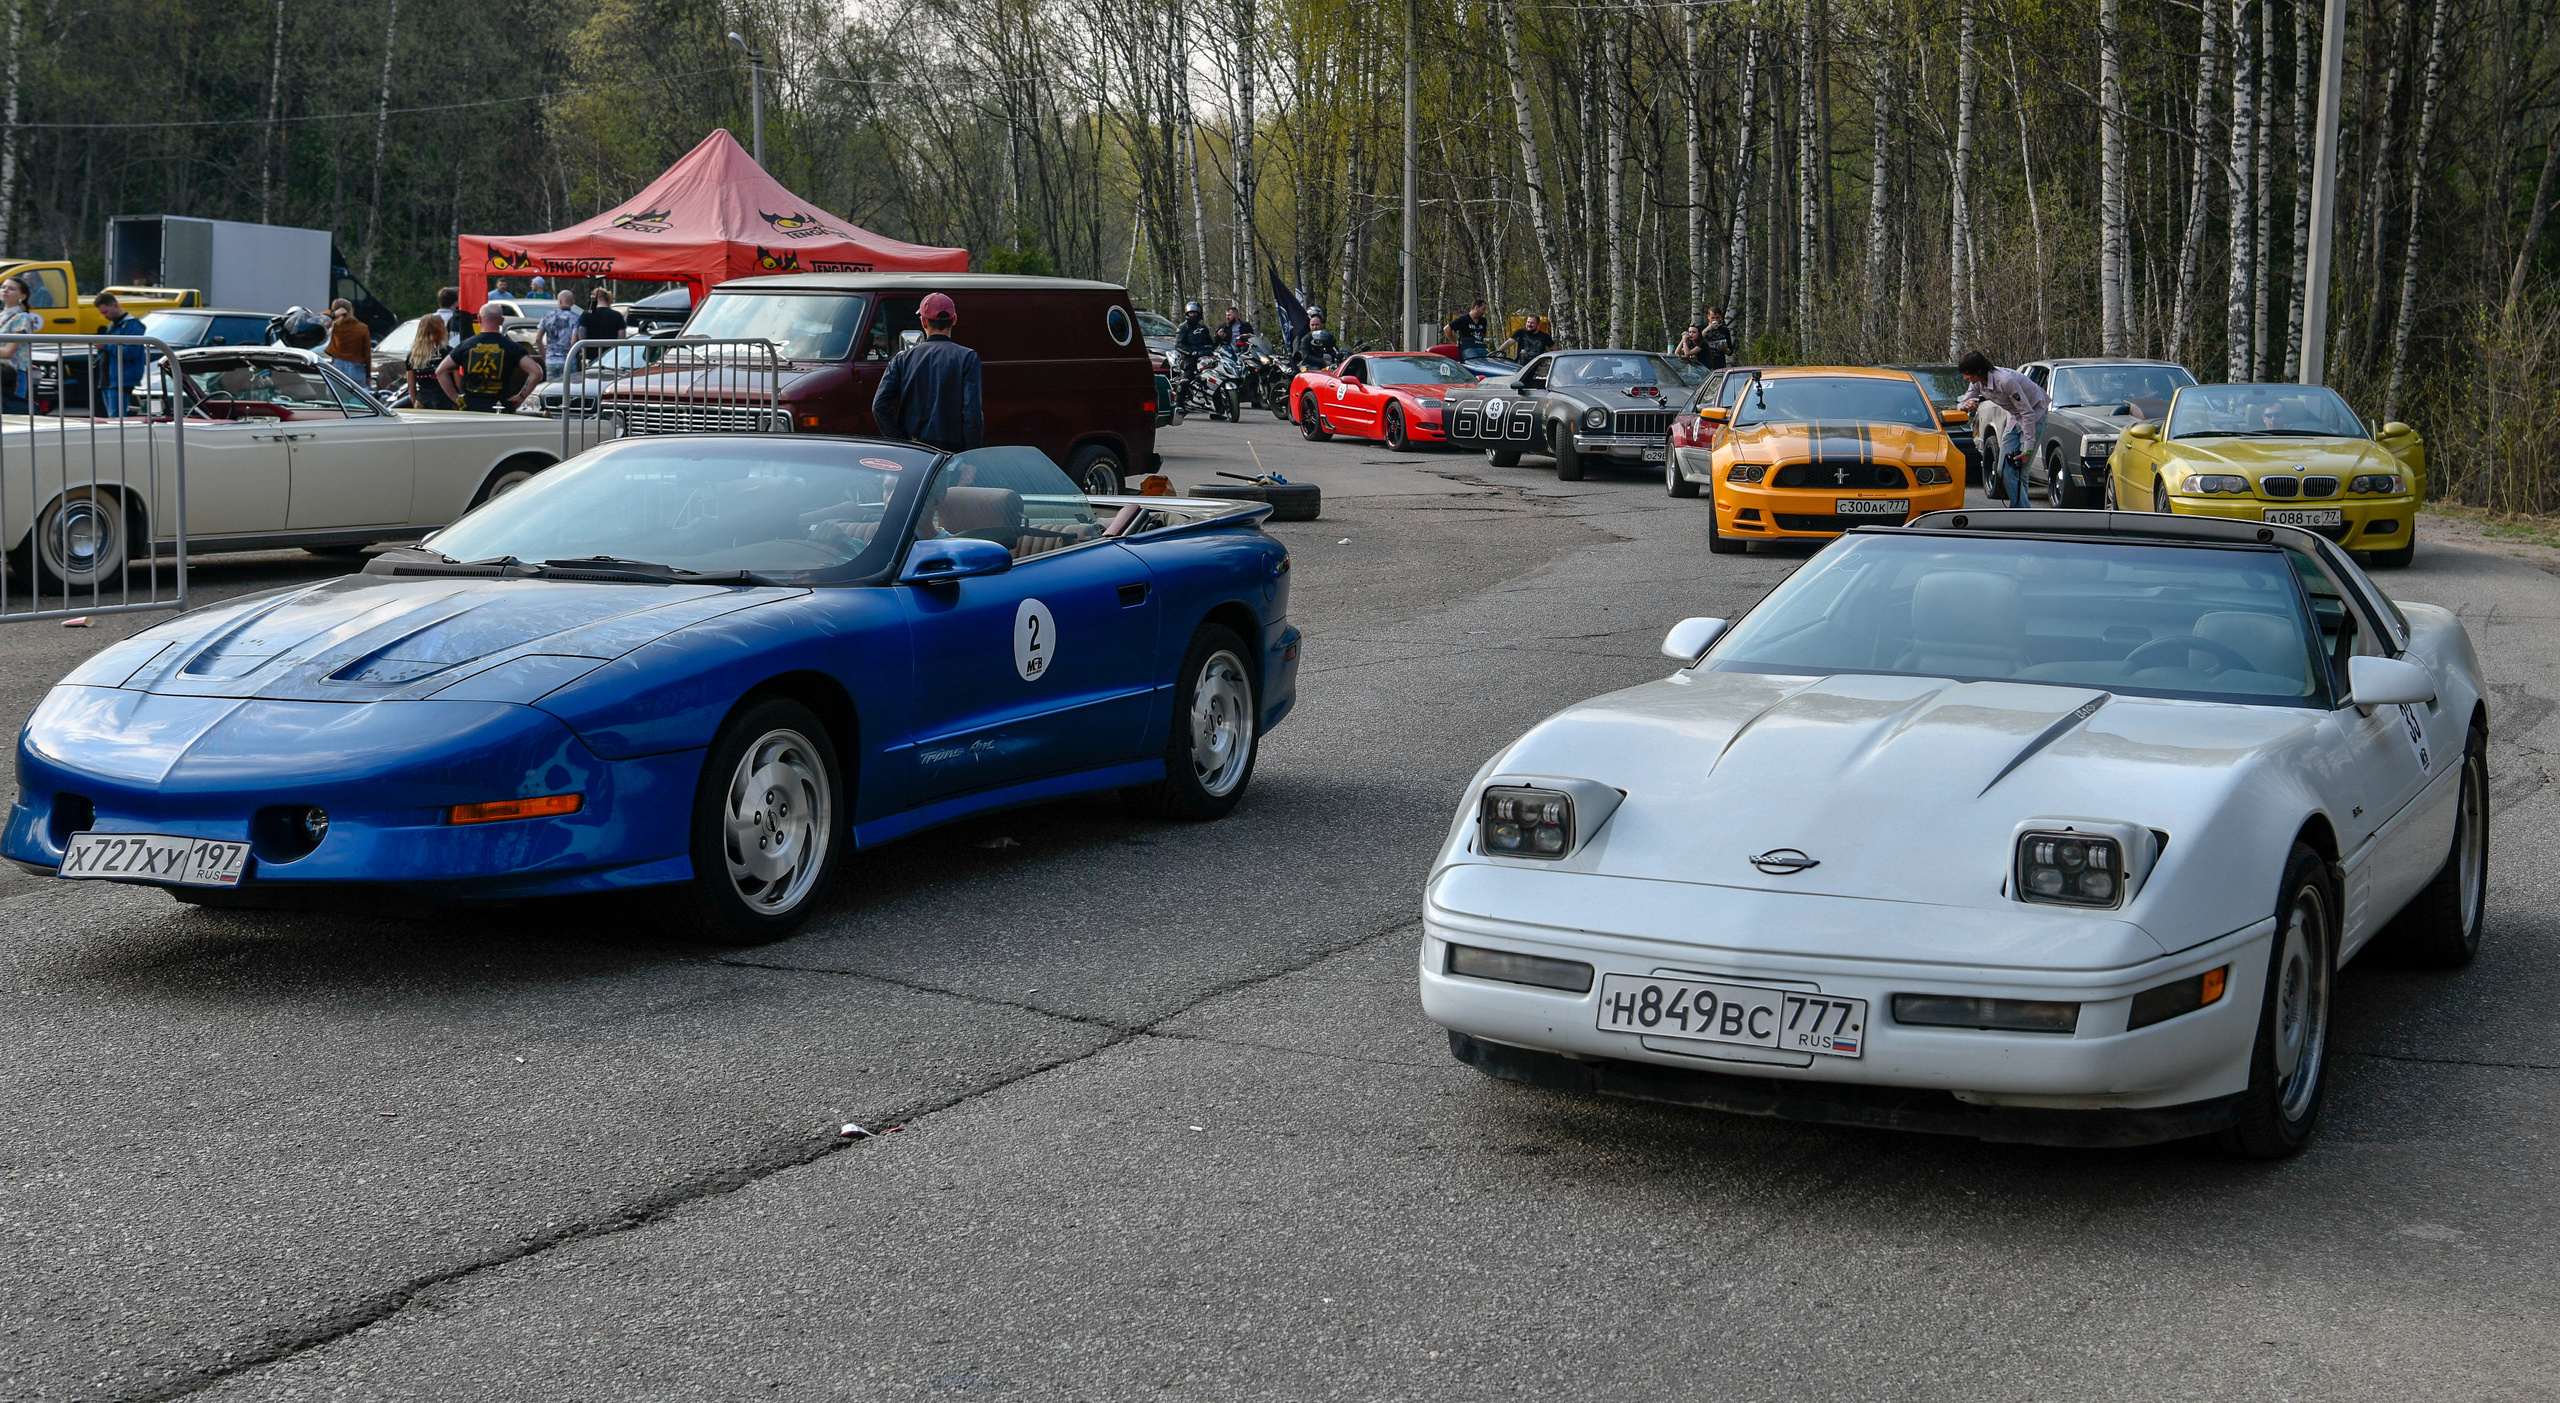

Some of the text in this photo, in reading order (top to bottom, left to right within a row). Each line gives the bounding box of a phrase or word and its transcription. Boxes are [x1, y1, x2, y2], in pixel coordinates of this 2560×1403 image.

[1452, 399, 1538, 441] 606
[1489, 401, 1501, 412] 43
[1839, 500, 1906, 513] C300AK 777
[1028, 614, 1041, 652] 2
[2399, 704, 2422, 744] 33
[67, 838, 242, 875] X727XY 197
[196, 870, 221, 881] RUS
[1611, 984, 1853, 1039] H849BC 777
[1797, 1033, 1832, 1049] RUS
